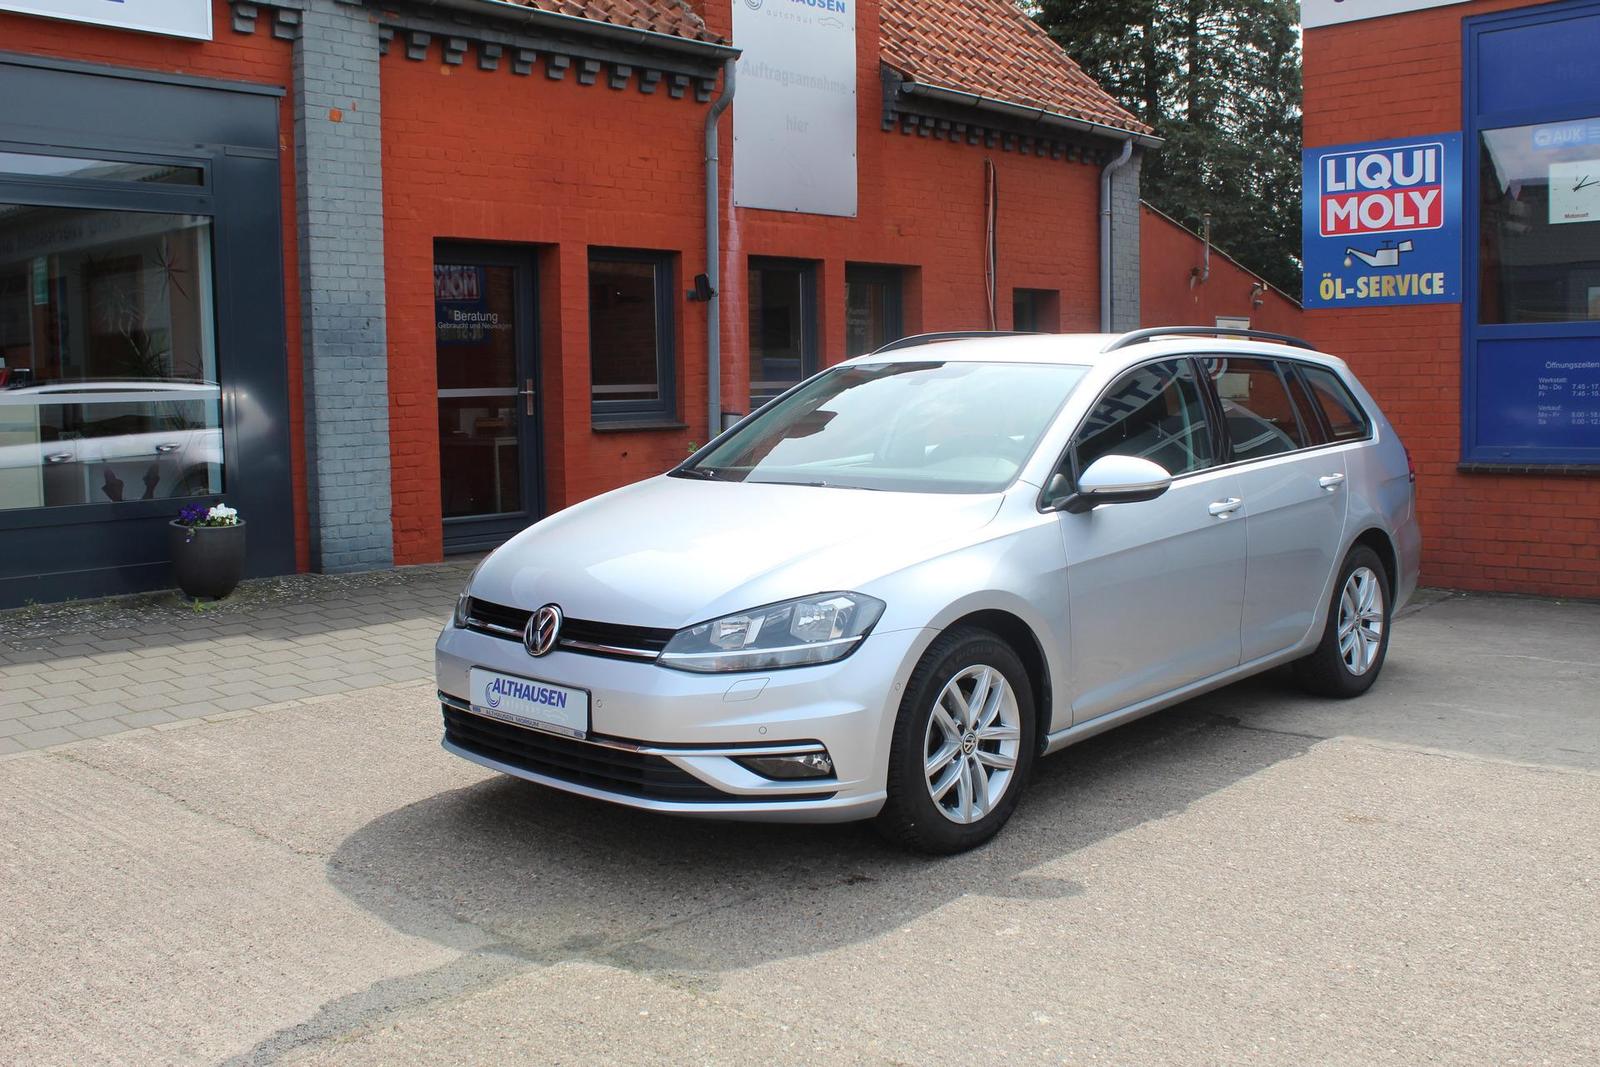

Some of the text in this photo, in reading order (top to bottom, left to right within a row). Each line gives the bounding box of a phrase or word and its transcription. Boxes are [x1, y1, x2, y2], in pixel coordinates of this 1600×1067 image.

[785, 114, 810, 133] hier
[1326, 149, 1436, 193] LIQUI
[1327, 189, 1440, 231] MOLY
[1320, 272, 1445, 300] ÖL-SERVICE
[454, 310, 498, 324] Beratung
[492, 677, 567, 708] ALTHAUSEN
